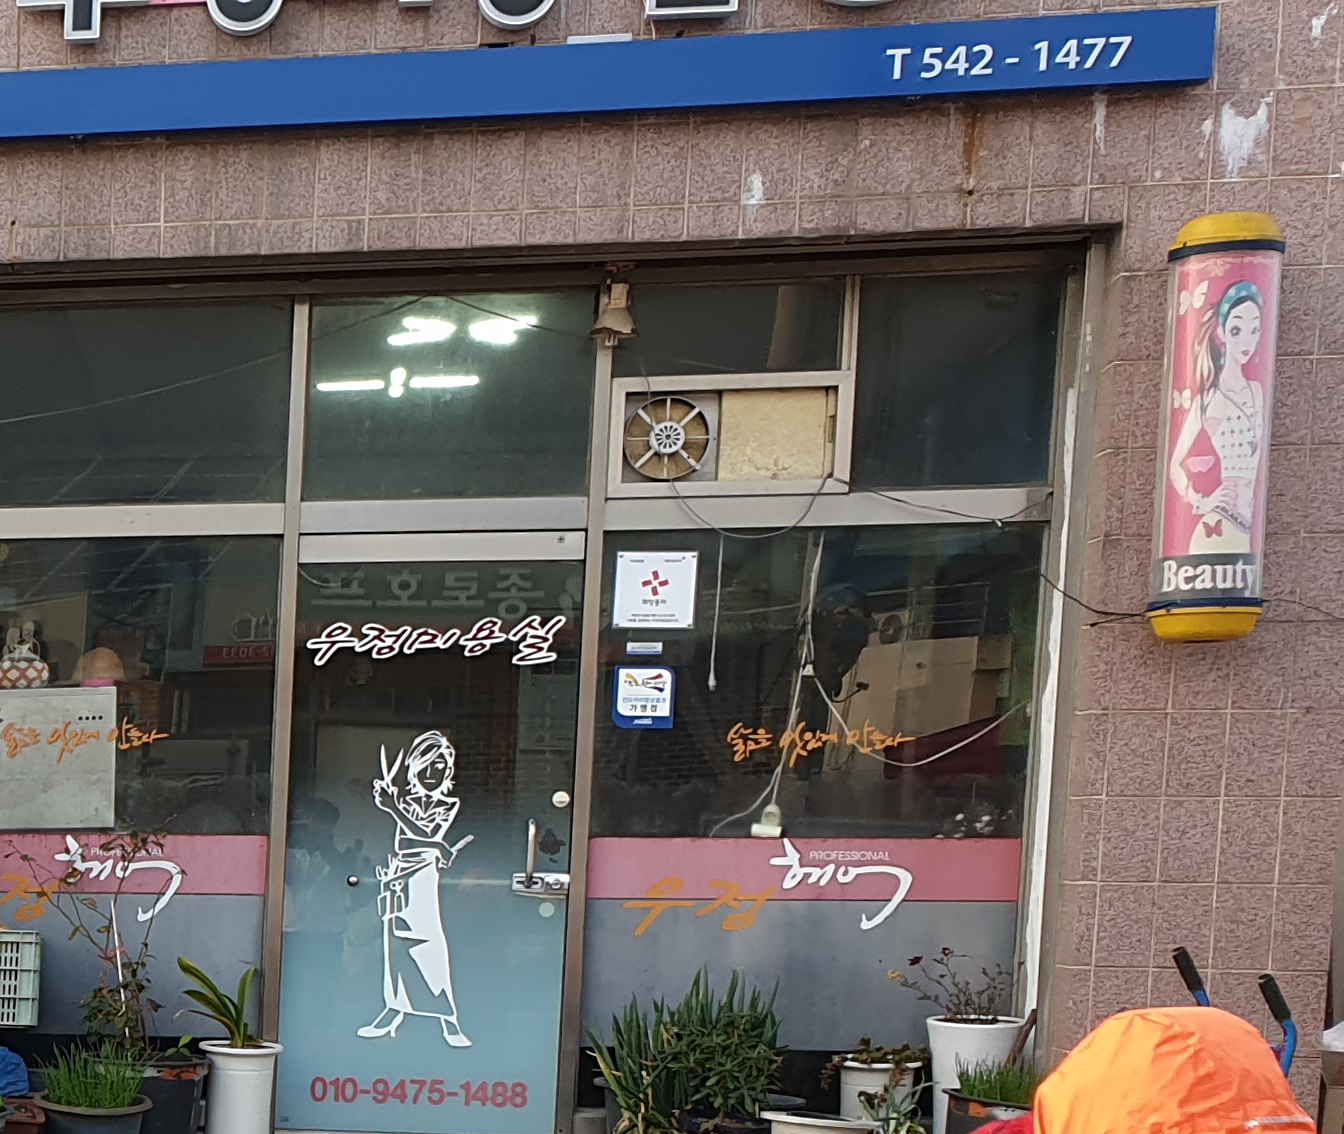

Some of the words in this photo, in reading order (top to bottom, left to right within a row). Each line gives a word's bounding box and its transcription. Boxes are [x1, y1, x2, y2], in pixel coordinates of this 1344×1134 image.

[1161, 558, 1257, 597] Beauty
[307, 616, 567, 667] 우정미용실
[629, 704, 659, 713] 가맹점
[810, 850, 891, 861] PROFESSIONAL
[622, 876, 777, 937] 우정
[310, 1076, 529, 1109] 010-9475-1488
